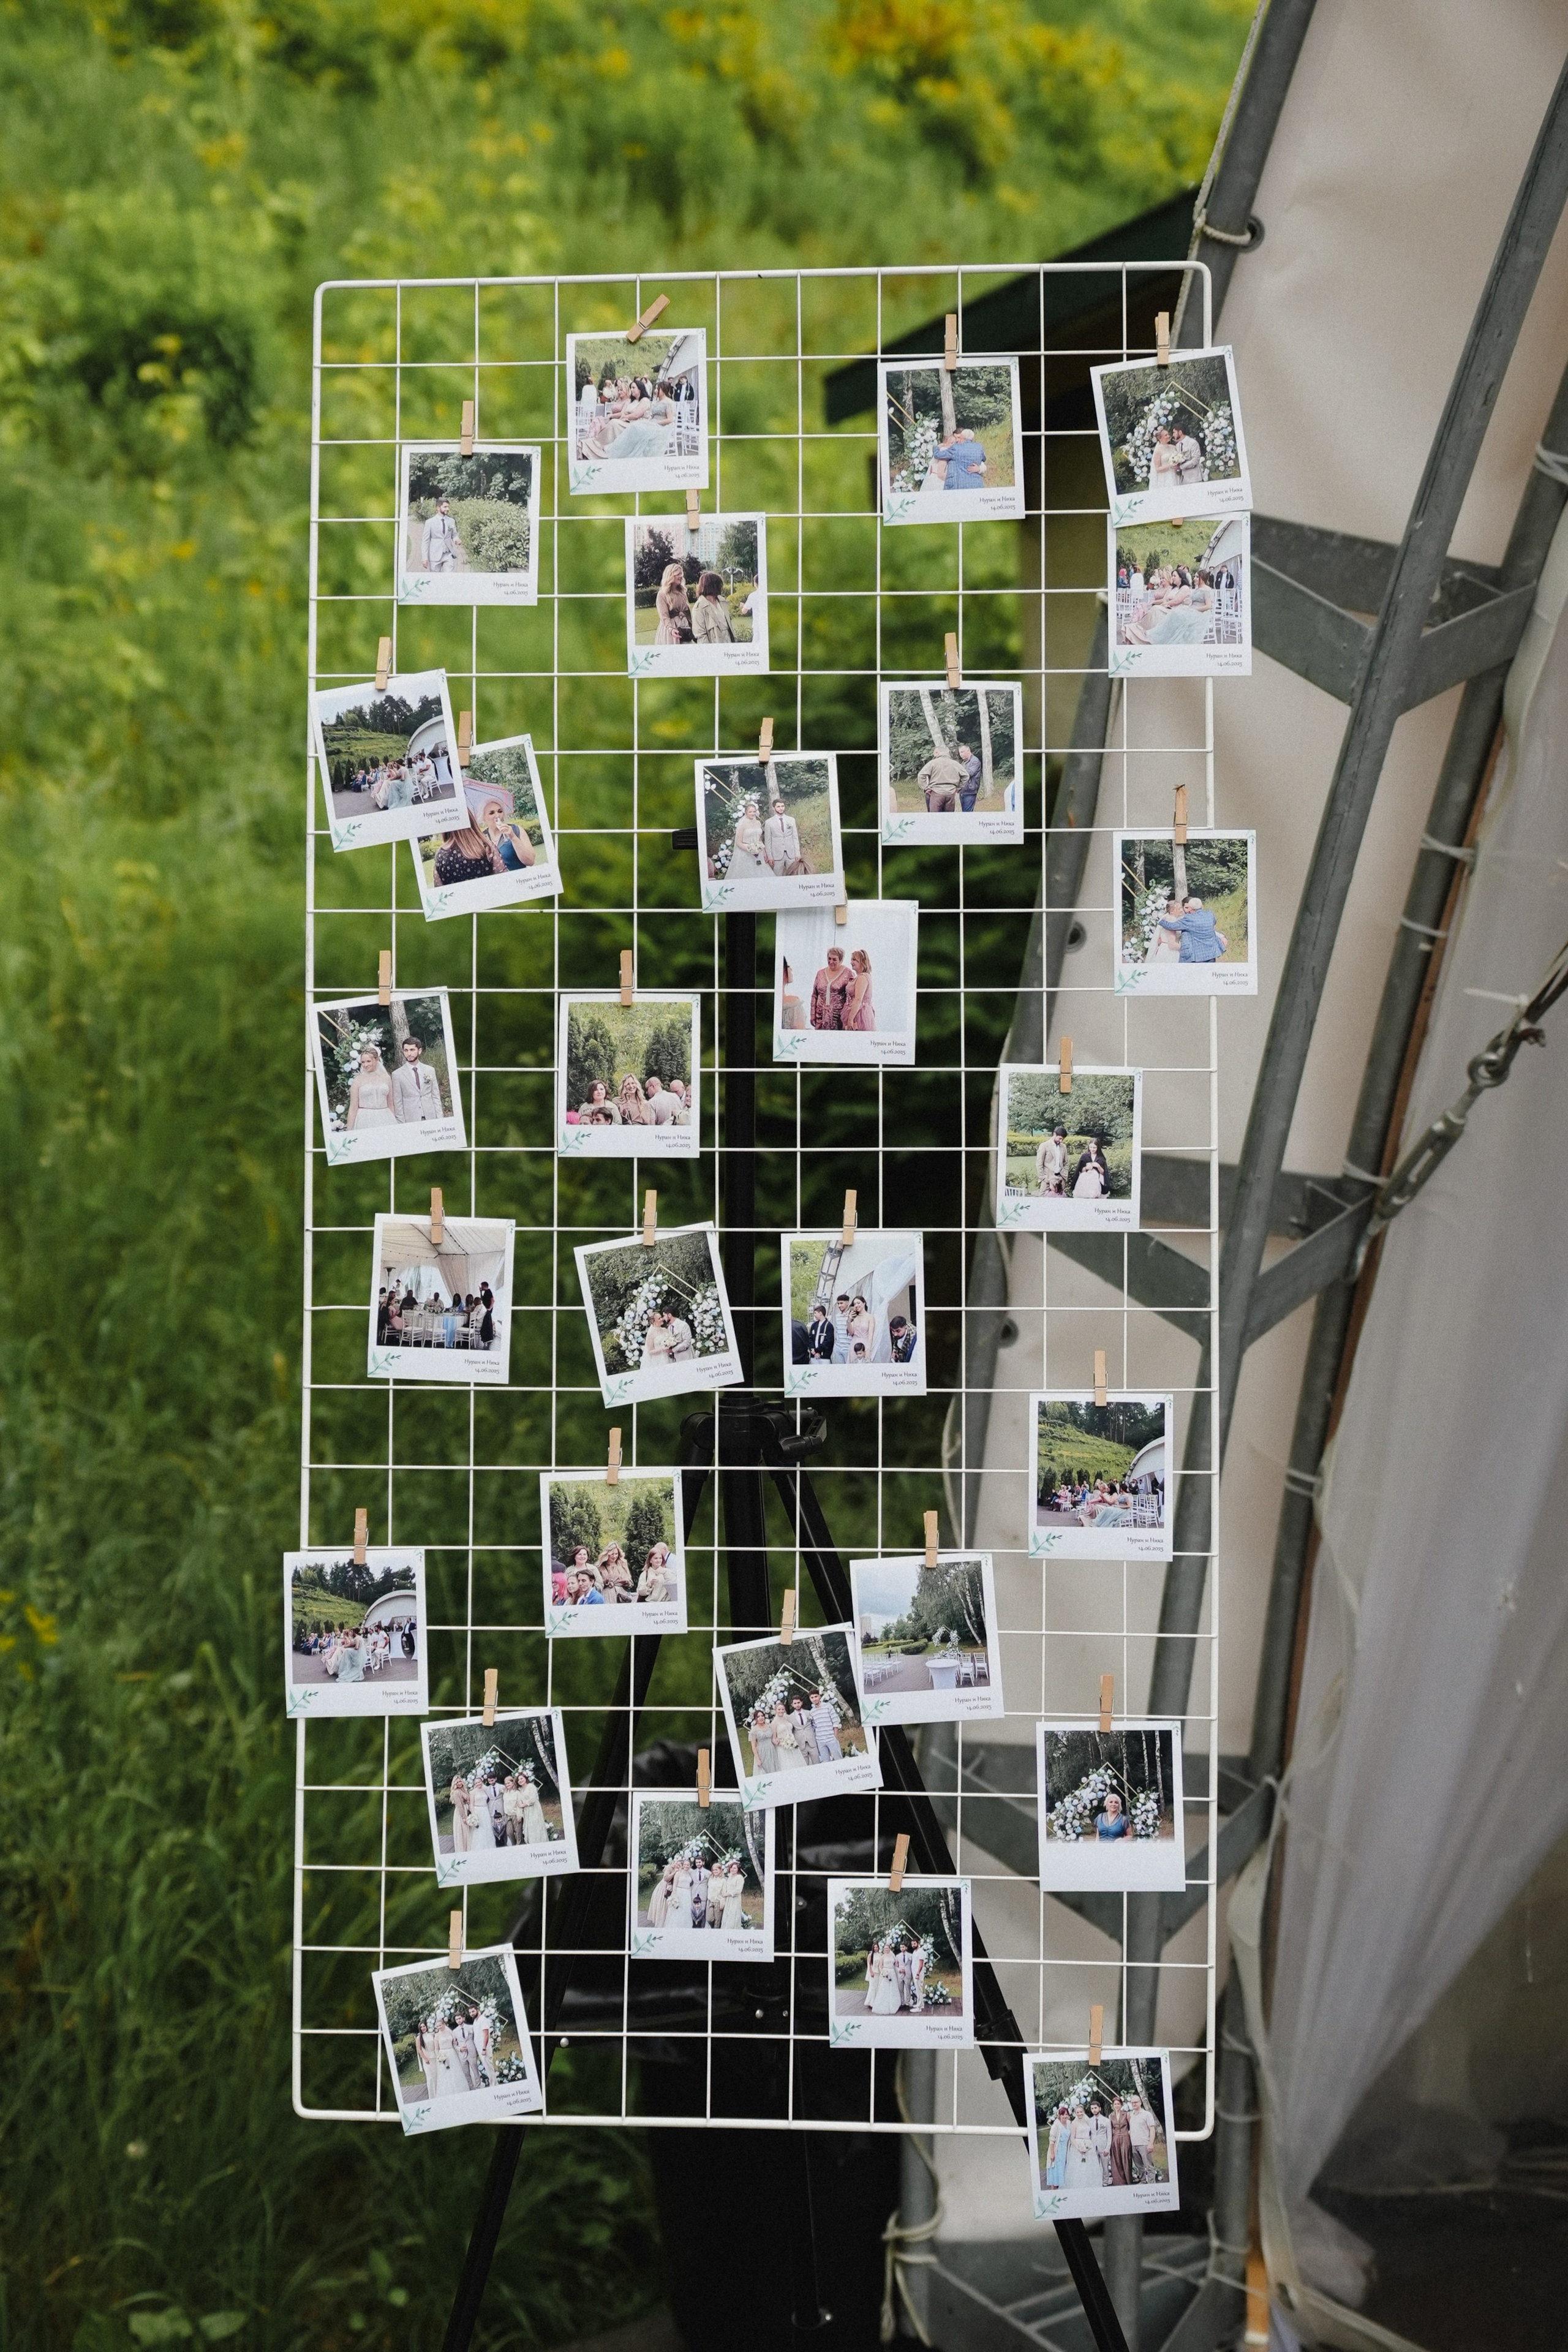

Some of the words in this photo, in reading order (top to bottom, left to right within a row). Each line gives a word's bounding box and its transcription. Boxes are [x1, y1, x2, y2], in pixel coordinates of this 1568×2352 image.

[435, 815, 460, 824] 14.06.2025
[528, 881, 553, 890] 14.06.2025
[709, 1370, 734, 1379] 14.06.2025
[848, 1773, 873, 1781] 14.06.2025
[507, 2097, 532, 2106] 14.06.2025
